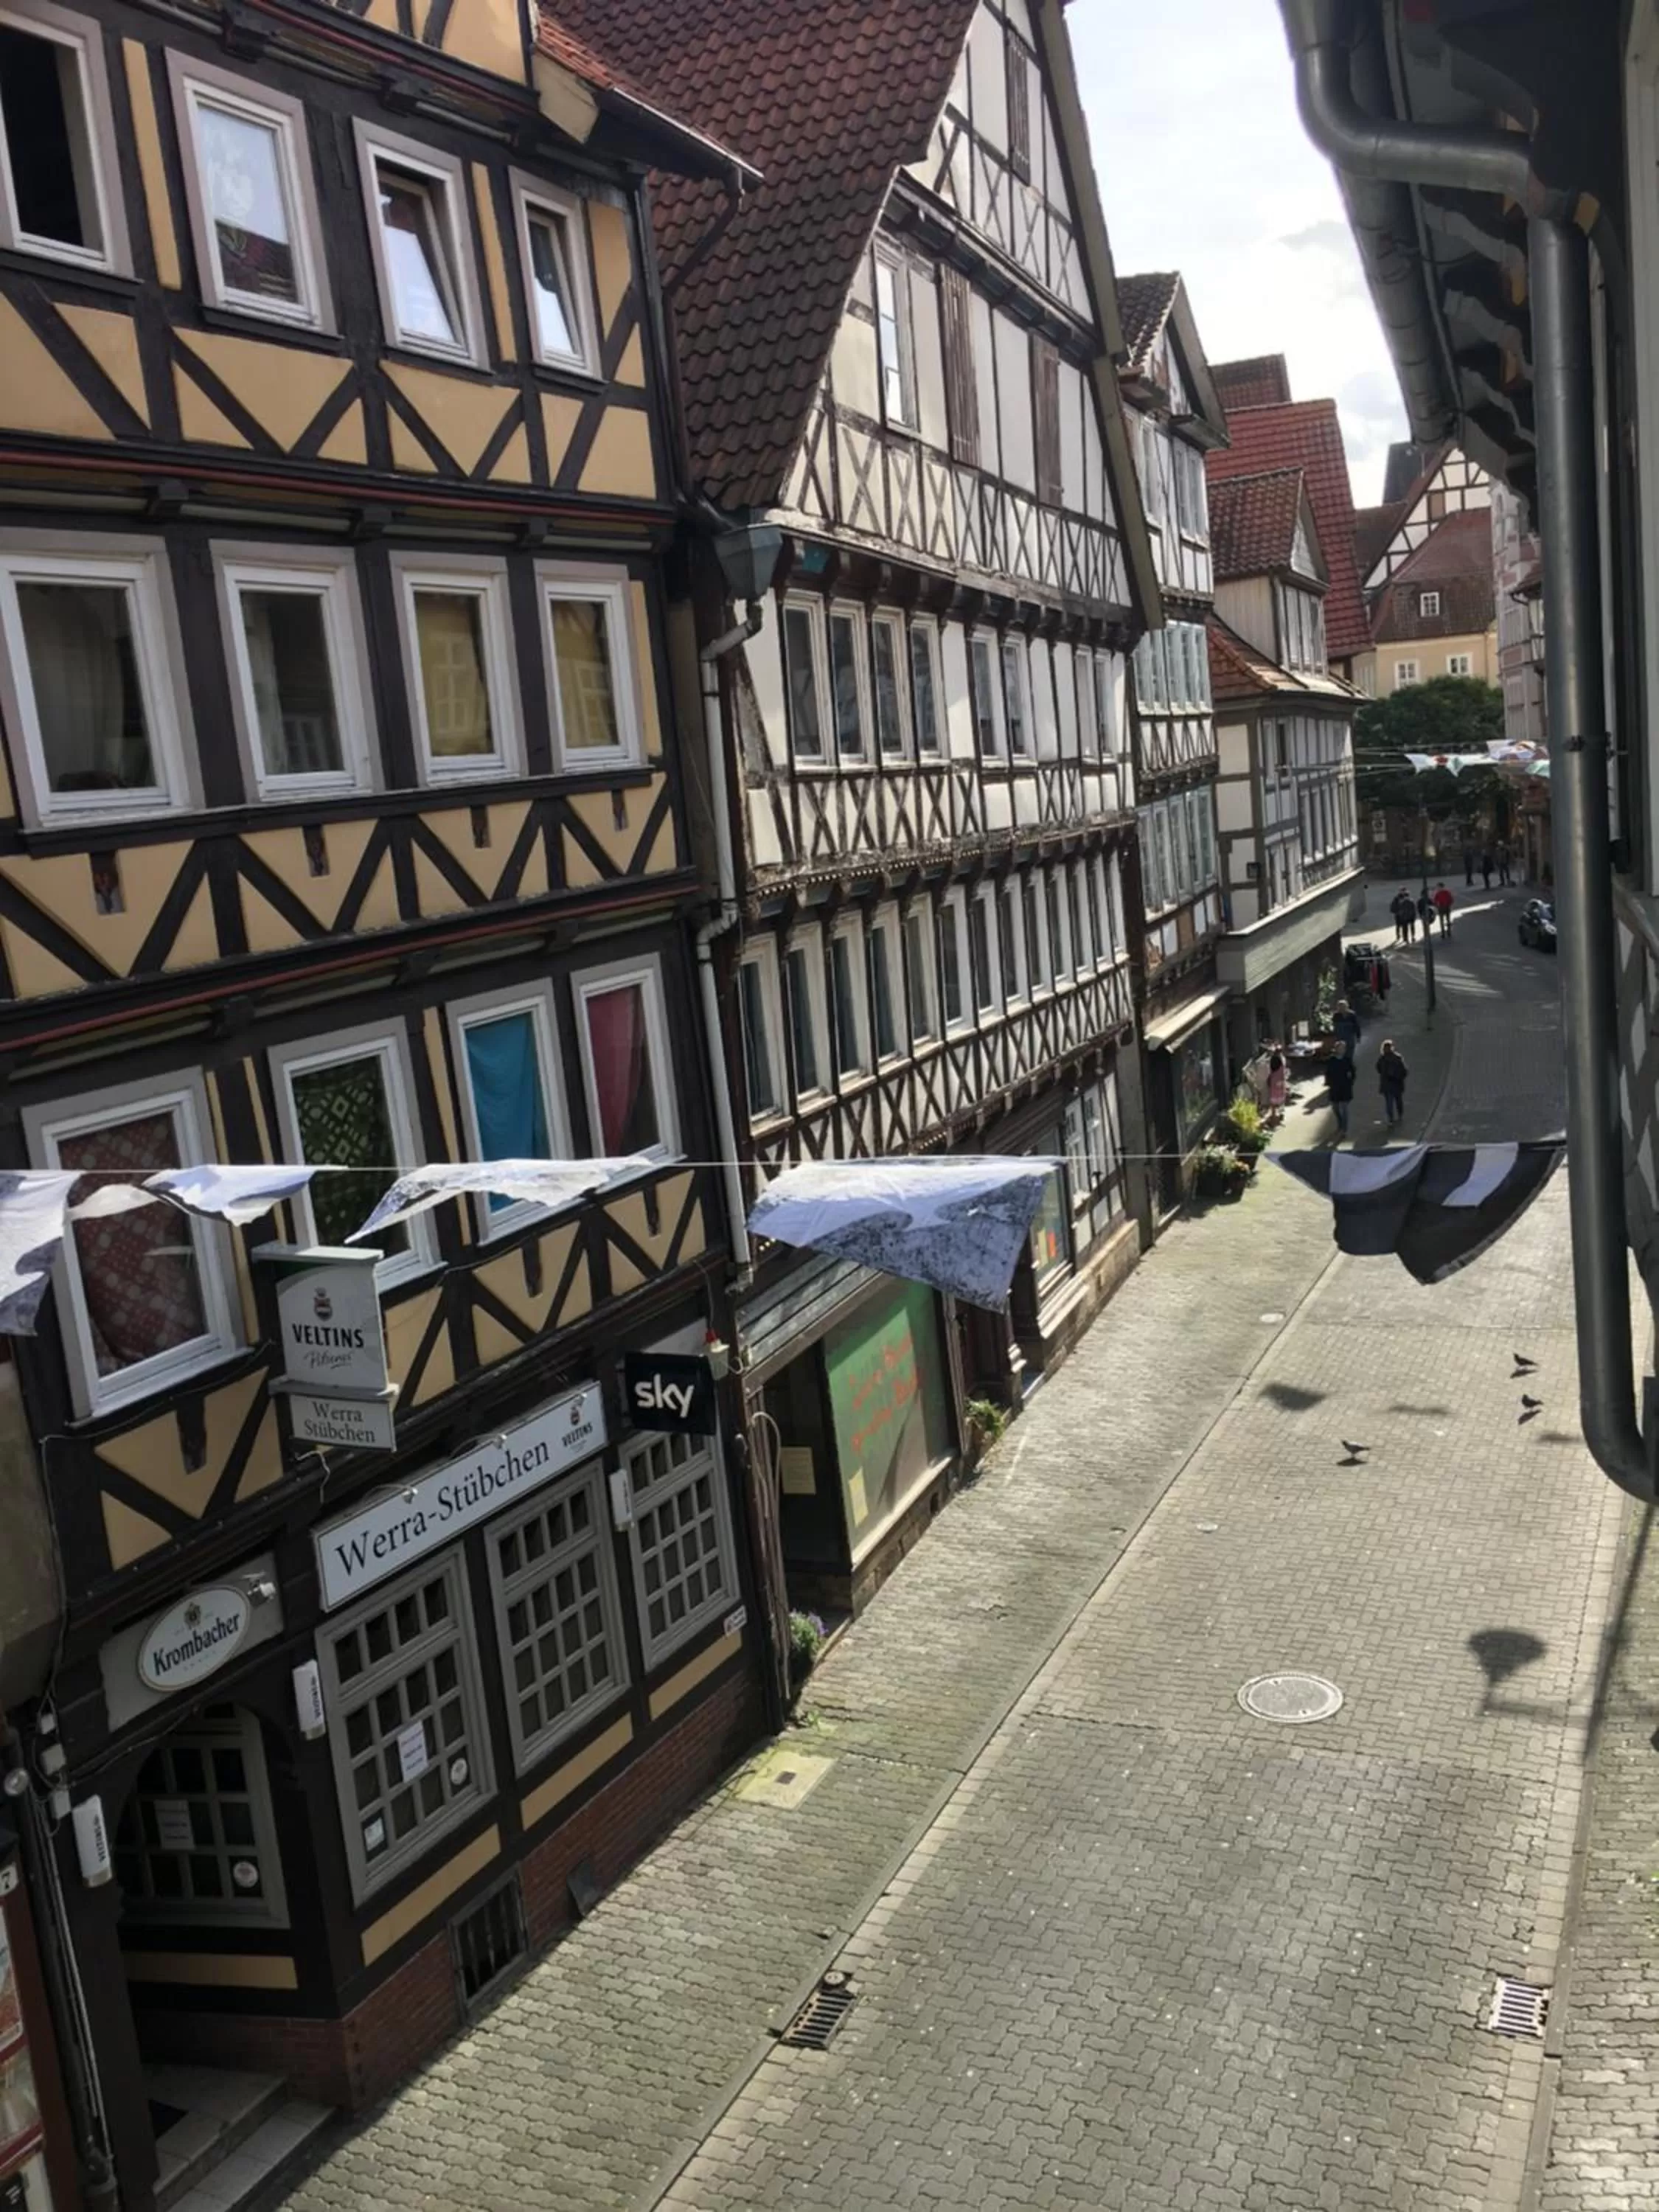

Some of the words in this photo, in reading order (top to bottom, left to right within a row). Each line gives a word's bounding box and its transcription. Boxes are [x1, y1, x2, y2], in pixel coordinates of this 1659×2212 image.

[292, 1324, 364, 1349] VELTINS
[634, 1373, 695, 1419] sky
[312, 1401, 364, 1423] Werra
[304, 1419, 376, 1444] Stübchen
[561, 1422, 594, 1447] VELTINS
[335, 1441, 550, 1577] Werra-Stübchen
[153, 1613, 240, 1677] Krombacher
